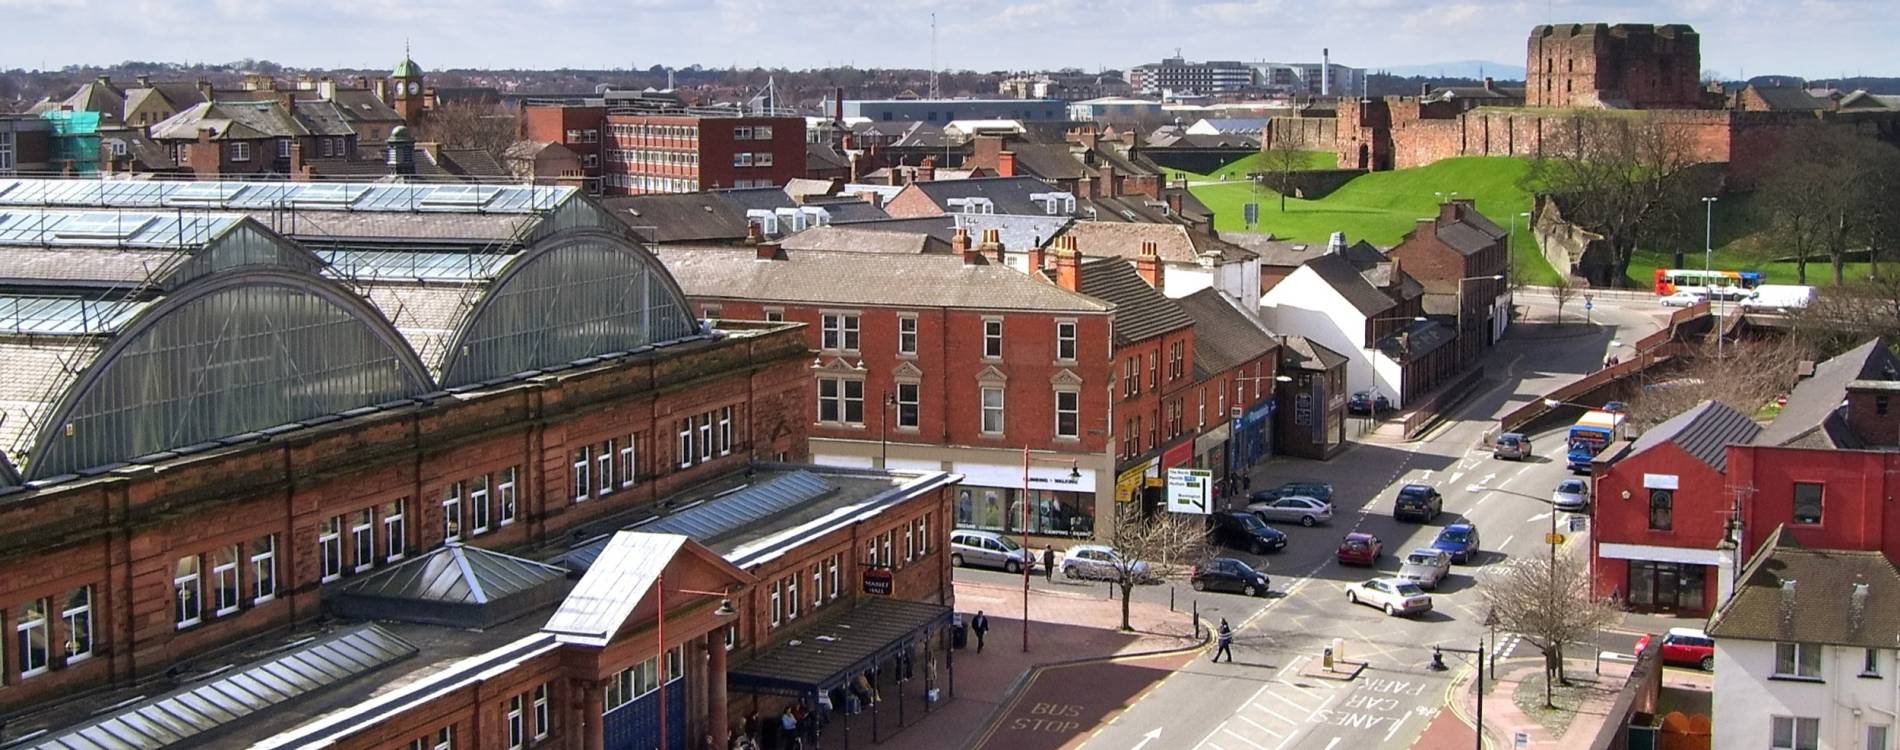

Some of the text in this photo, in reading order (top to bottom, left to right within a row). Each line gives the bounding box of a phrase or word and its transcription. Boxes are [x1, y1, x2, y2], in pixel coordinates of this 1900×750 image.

[1357, 678, 1426, 696] PARK
[1031, 702, 1084, 717] BUS
[1345, 694, 1399, 711] CAR
[1011, 718, 1080, 733] STOP
[1312, 709, 1401, 732] LANES
